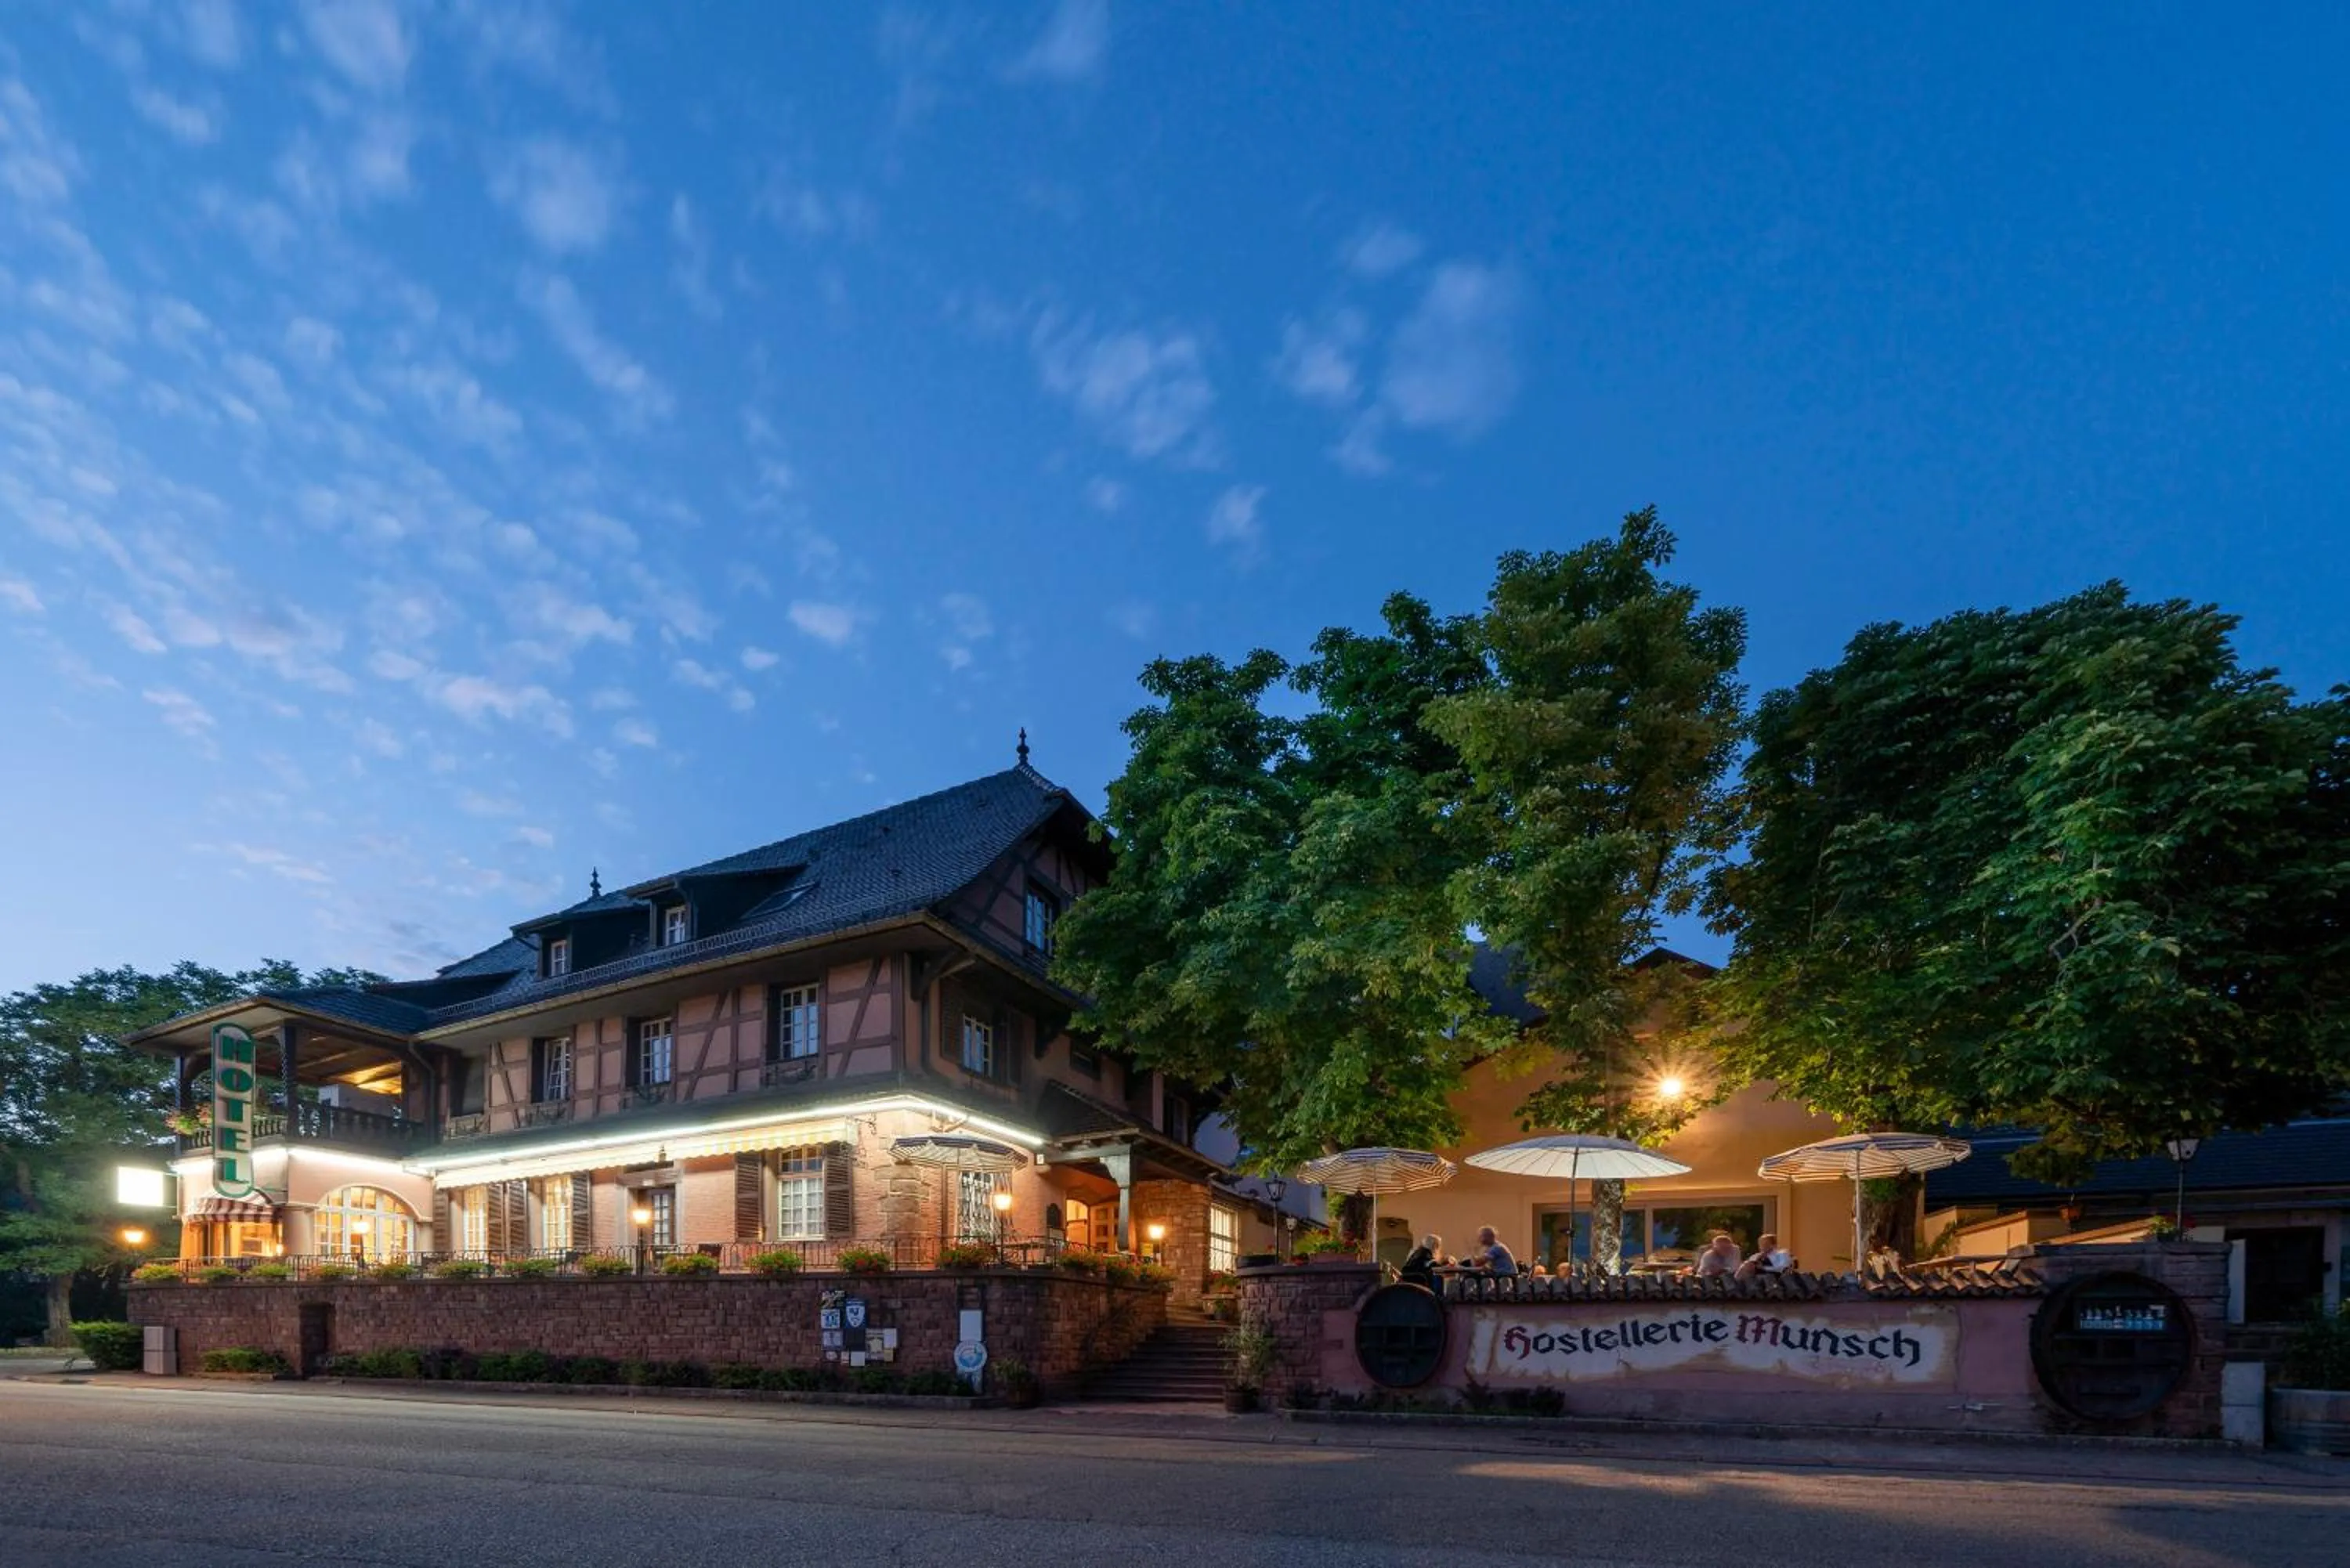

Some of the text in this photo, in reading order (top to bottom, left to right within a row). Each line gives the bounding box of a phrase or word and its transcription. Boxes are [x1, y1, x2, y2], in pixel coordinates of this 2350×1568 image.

[219, 1035, 253, 1183] HOTEL
[1505, 1314, 1920, 1367] Hostellerie Munsch
